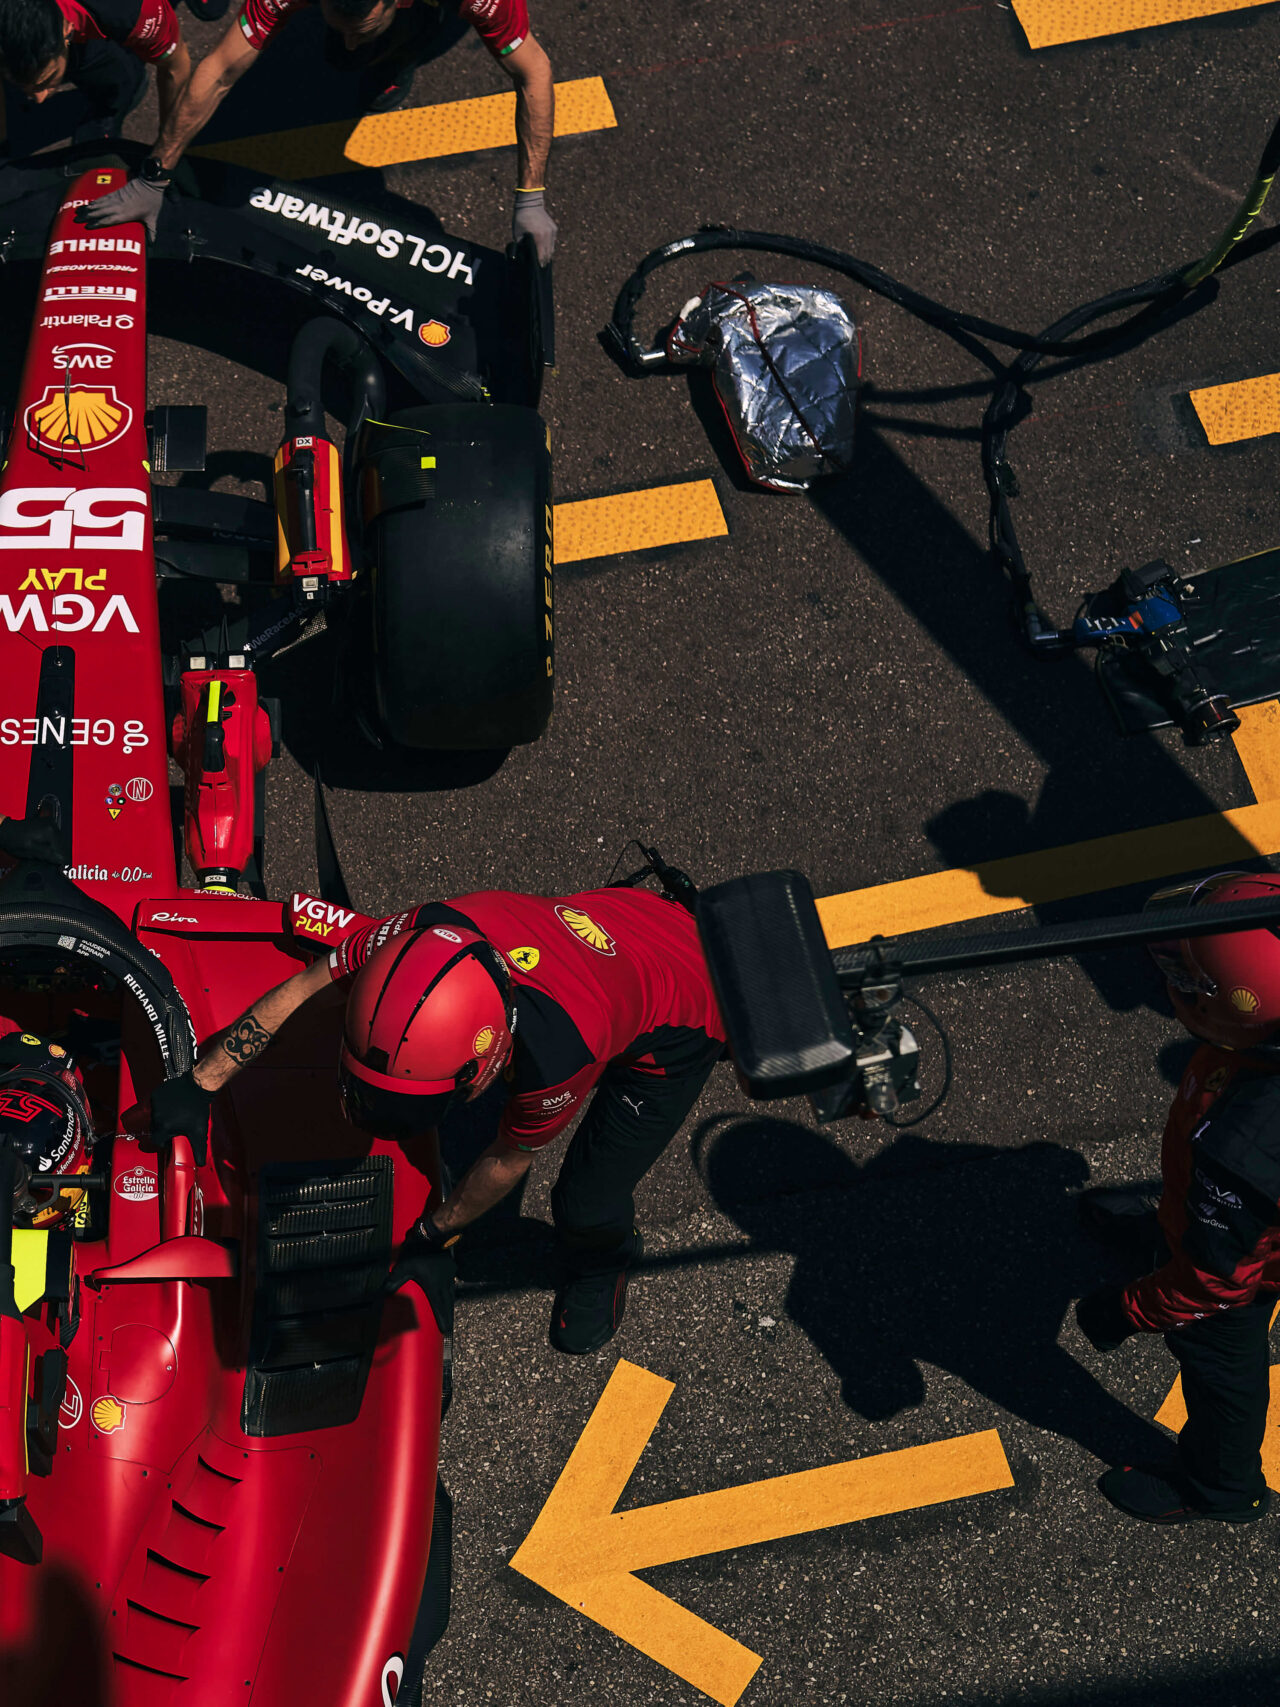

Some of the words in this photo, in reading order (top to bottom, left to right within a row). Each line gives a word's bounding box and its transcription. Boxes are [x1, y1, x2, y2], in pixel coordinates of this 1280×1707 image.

[249, 186, 483, 286] HCLSoftware
[49, 239, 141, 256] MAHLE
[43, 286, 137, 303] PIRELLI
[295, 264, 415, 332] V-Power
[40, 315, 112, 329] Palantir
[52, 352, 115, 370] aws
[17, 568, 107, 591] PLAY
[194, 889, 261, 901] UTOMOTIVE
[151, 912, 199, 923] Riva
[293, 894, 356, 929] VGW
[295, 915, 334, 937] PLAY
[78, 943, 105, 959] FERRARI
[123, 973, 159, 1021] RICHARD
[153, 1023, 171, 1060] MILLE
[51, 1103, 75, 1162] Santander
[123, 1176, 155, 1184] Estrella
[123, 1184, 154, 1193] Galicia
